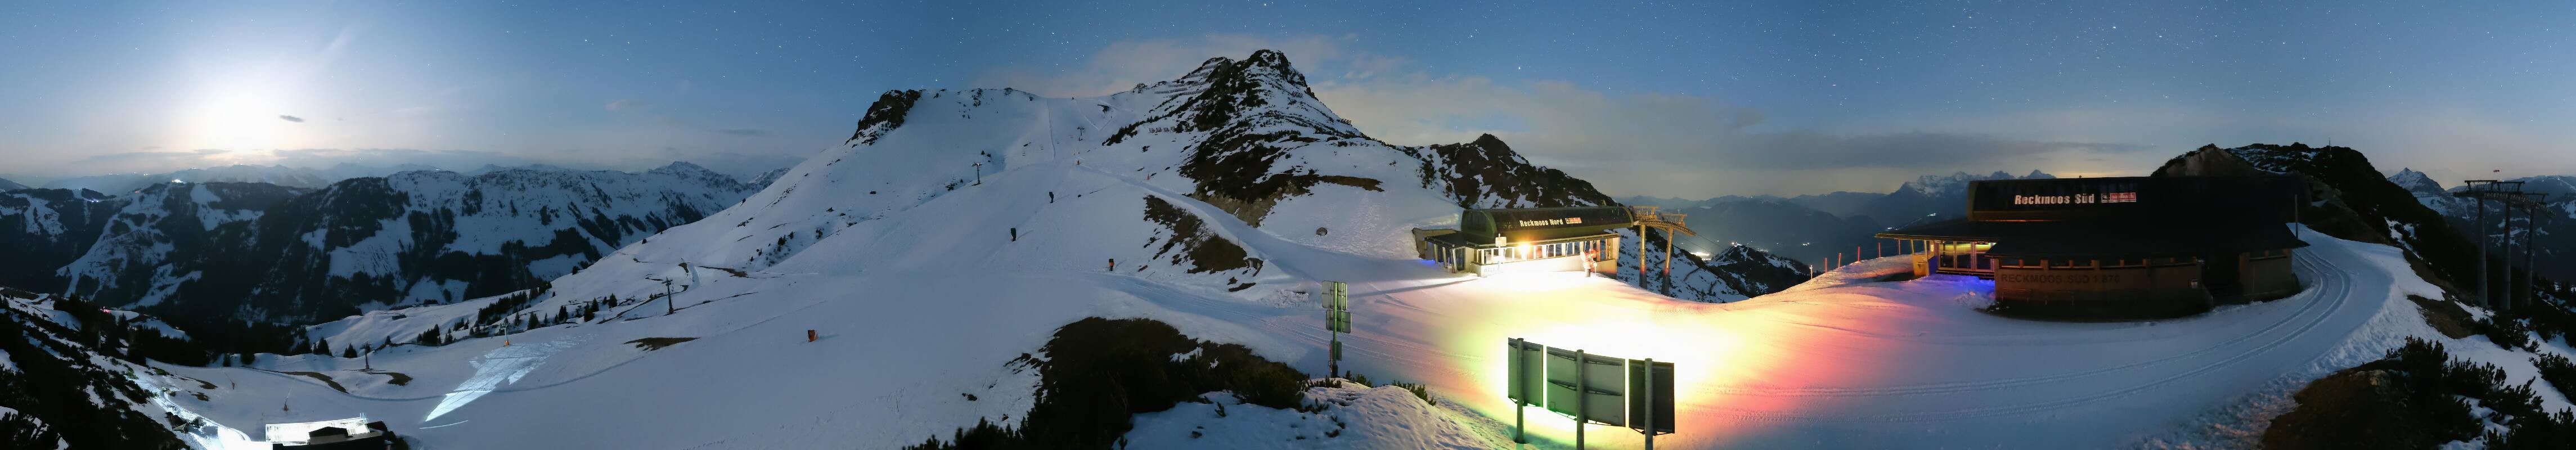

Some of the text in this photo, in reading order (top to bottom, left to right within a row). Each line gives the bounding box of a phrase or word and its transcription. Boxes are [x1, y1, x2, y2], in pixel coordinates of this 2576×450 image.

[2015, 193, 2094, 205] Reckmoos Süd
[2001, 274, 2062, 283] RECKMOOS
